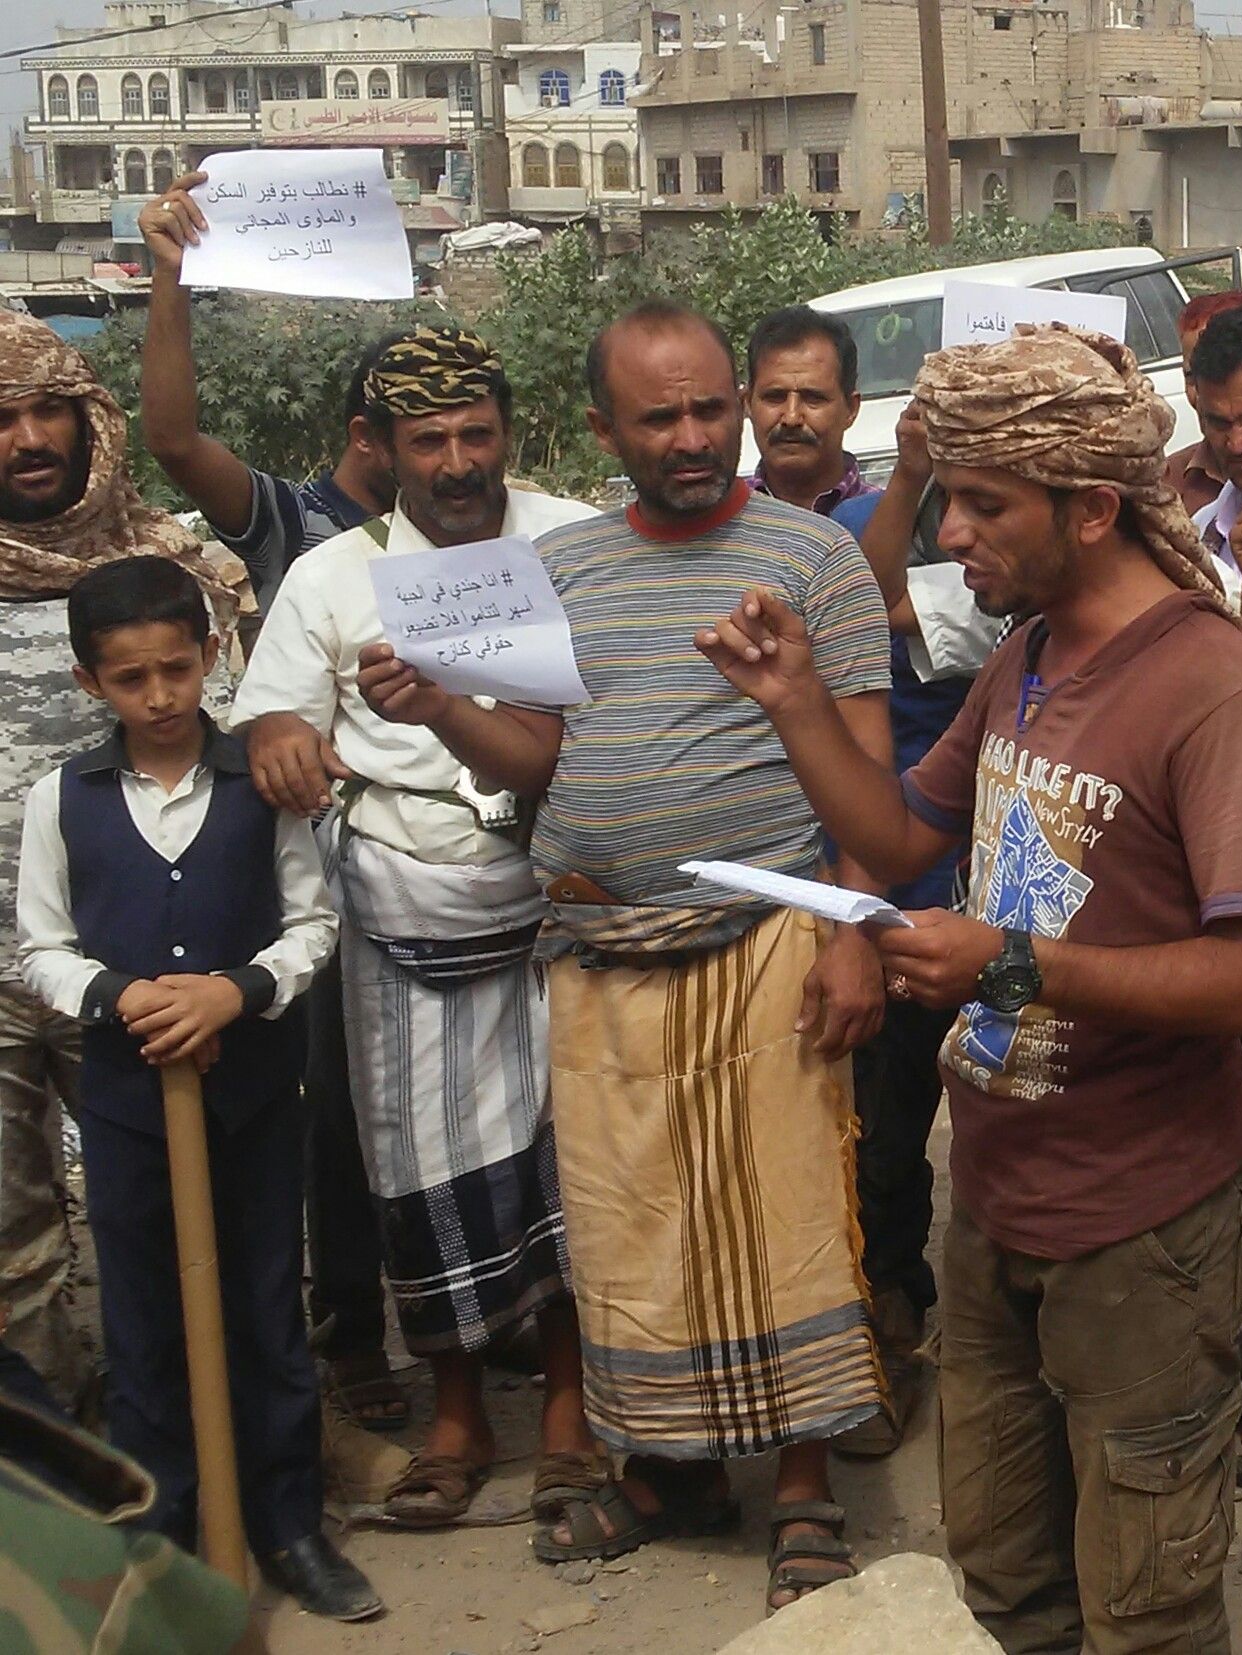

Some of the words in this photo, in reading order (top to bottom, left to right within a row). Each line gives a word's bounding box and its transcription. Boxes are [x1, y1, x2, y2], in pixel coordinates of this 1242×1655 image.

[207, 182, 247, 203] السكن
[257, 184, 297, 203] بتوفير
[303, 181, 350, 202] نطالب
[235, 212, 290, 234] المجاني
[268, 238, 333, 261] للنازحين
[432, 581, 446, 604] في
[450, 579, 482, 600] جندي
[437, 640, 471, 666] كنازح
[476, 634, 514, 660] حقوقي
[1015, 750, 1072, 800] LIKE
[1069, 773, 1123, 821] IT?
